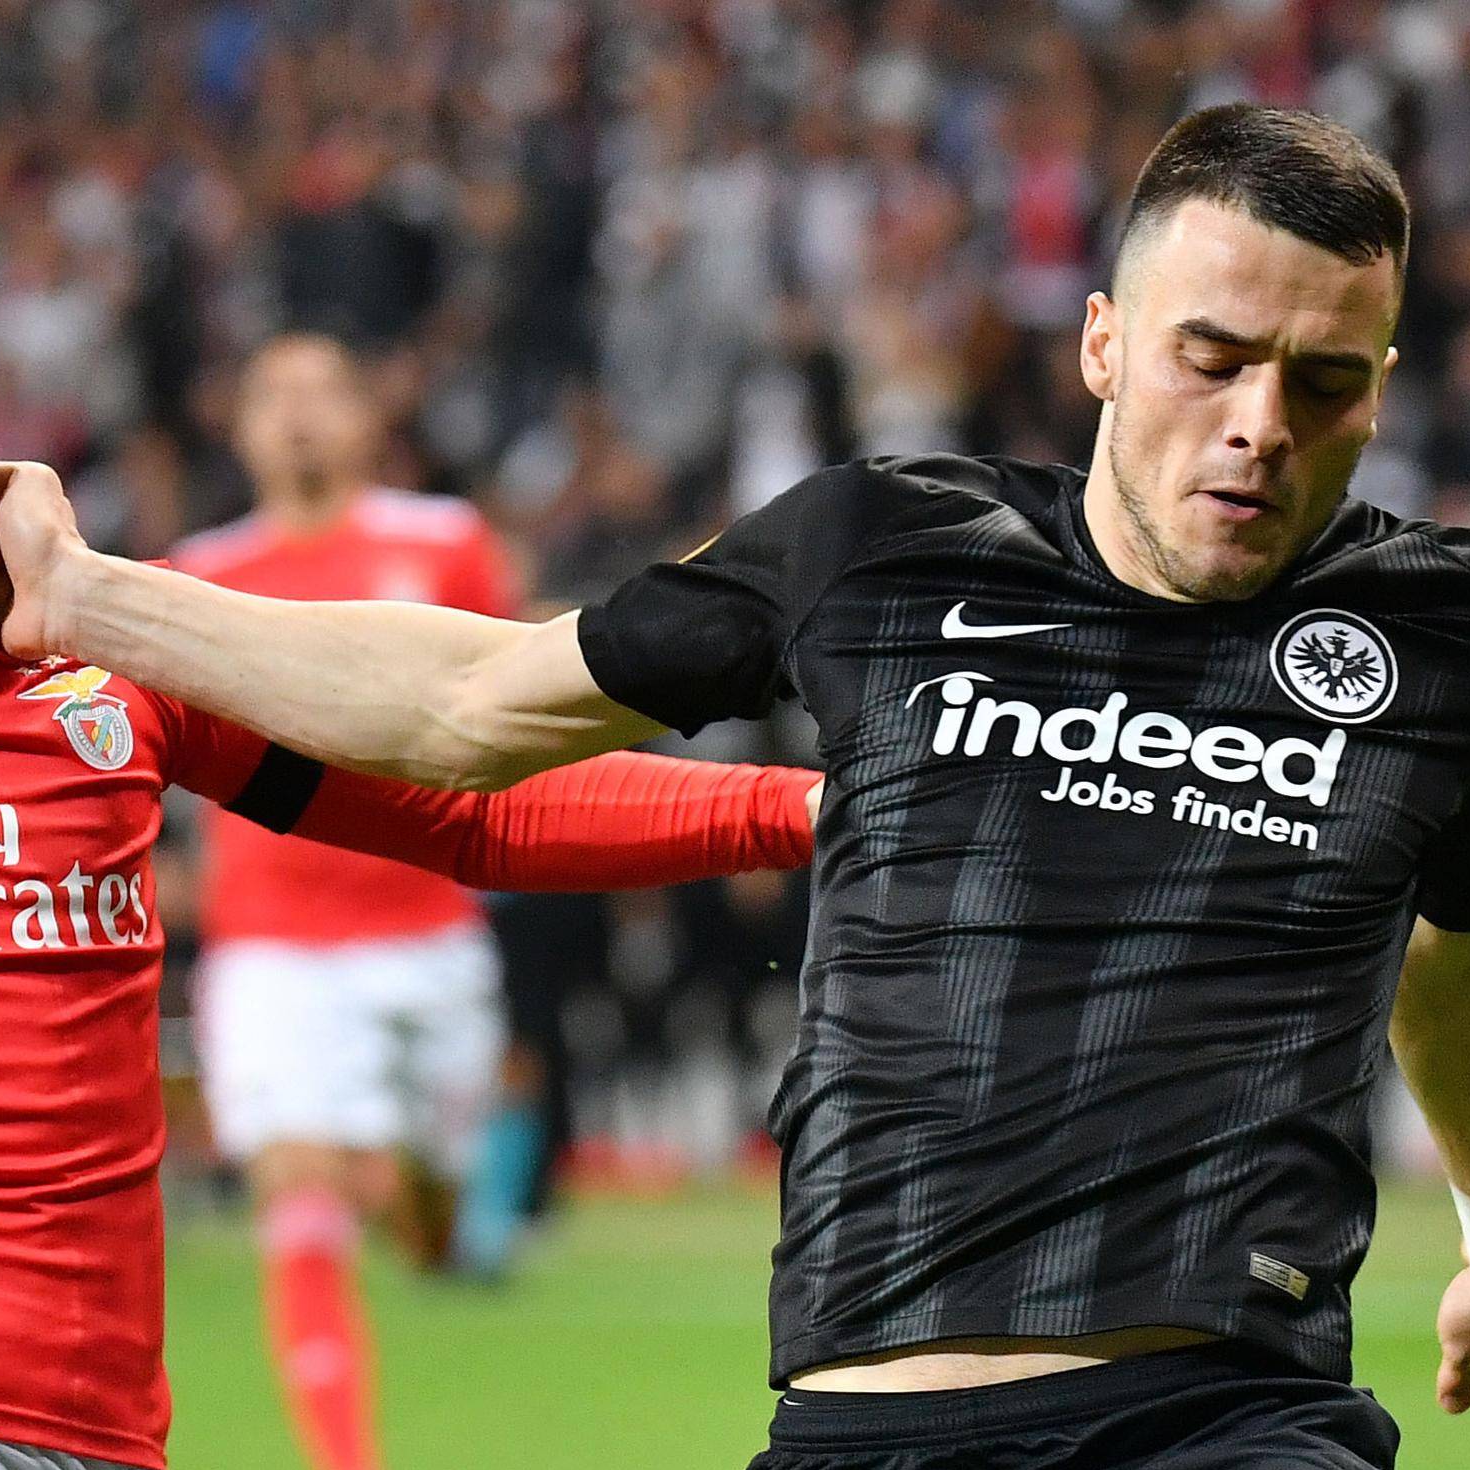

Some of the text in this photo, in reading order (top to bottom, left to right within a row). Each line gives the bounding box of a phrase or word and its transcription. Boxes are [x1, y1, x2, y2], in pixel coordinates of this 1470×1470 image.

[931, 676, 1347, 807] indeed
[1040, 767, 1319, 851] Jobs finden
